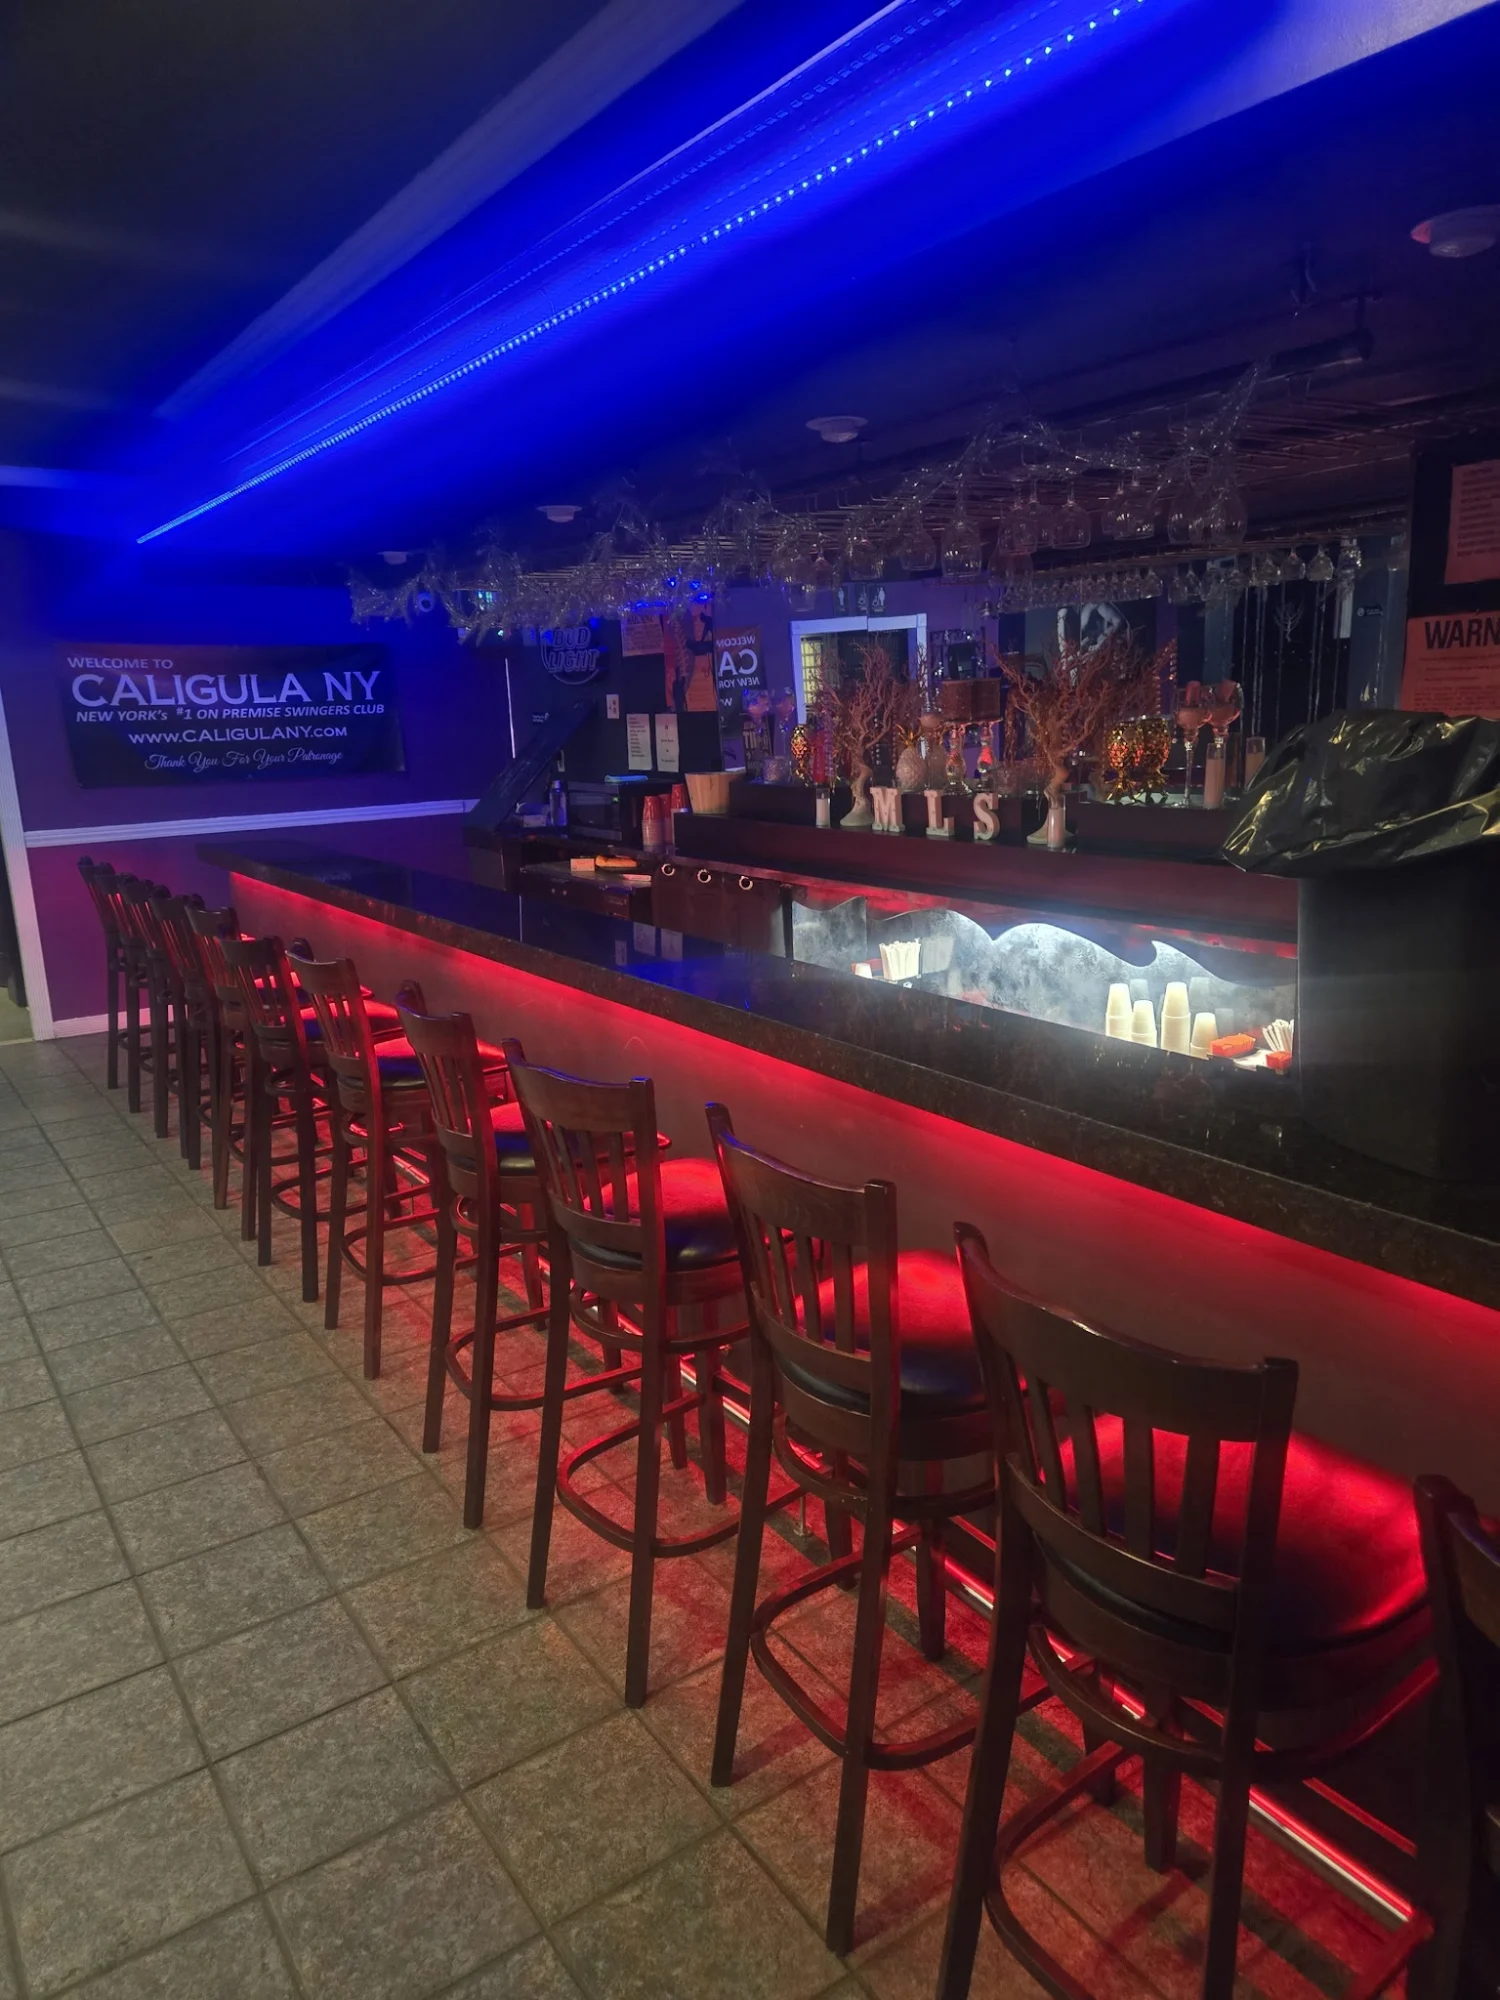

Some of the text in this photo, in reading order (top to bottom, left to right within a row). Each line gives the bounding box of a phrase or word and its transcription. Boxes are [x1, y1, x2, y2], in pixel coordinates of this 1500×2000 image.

[553, 626, 591, 650] BUD
[67, 657, 174, 670] WELCOME TO
[548, 648, 600, 673] LIGHT
[72, 670, 381, 707] CALIGULA NY
[76, 703, 385, 723] NEW YORK's #1 ON PREMISE SWINGERS CLUB
[144, 747, 343, 774] Thank You For Your Patronage
